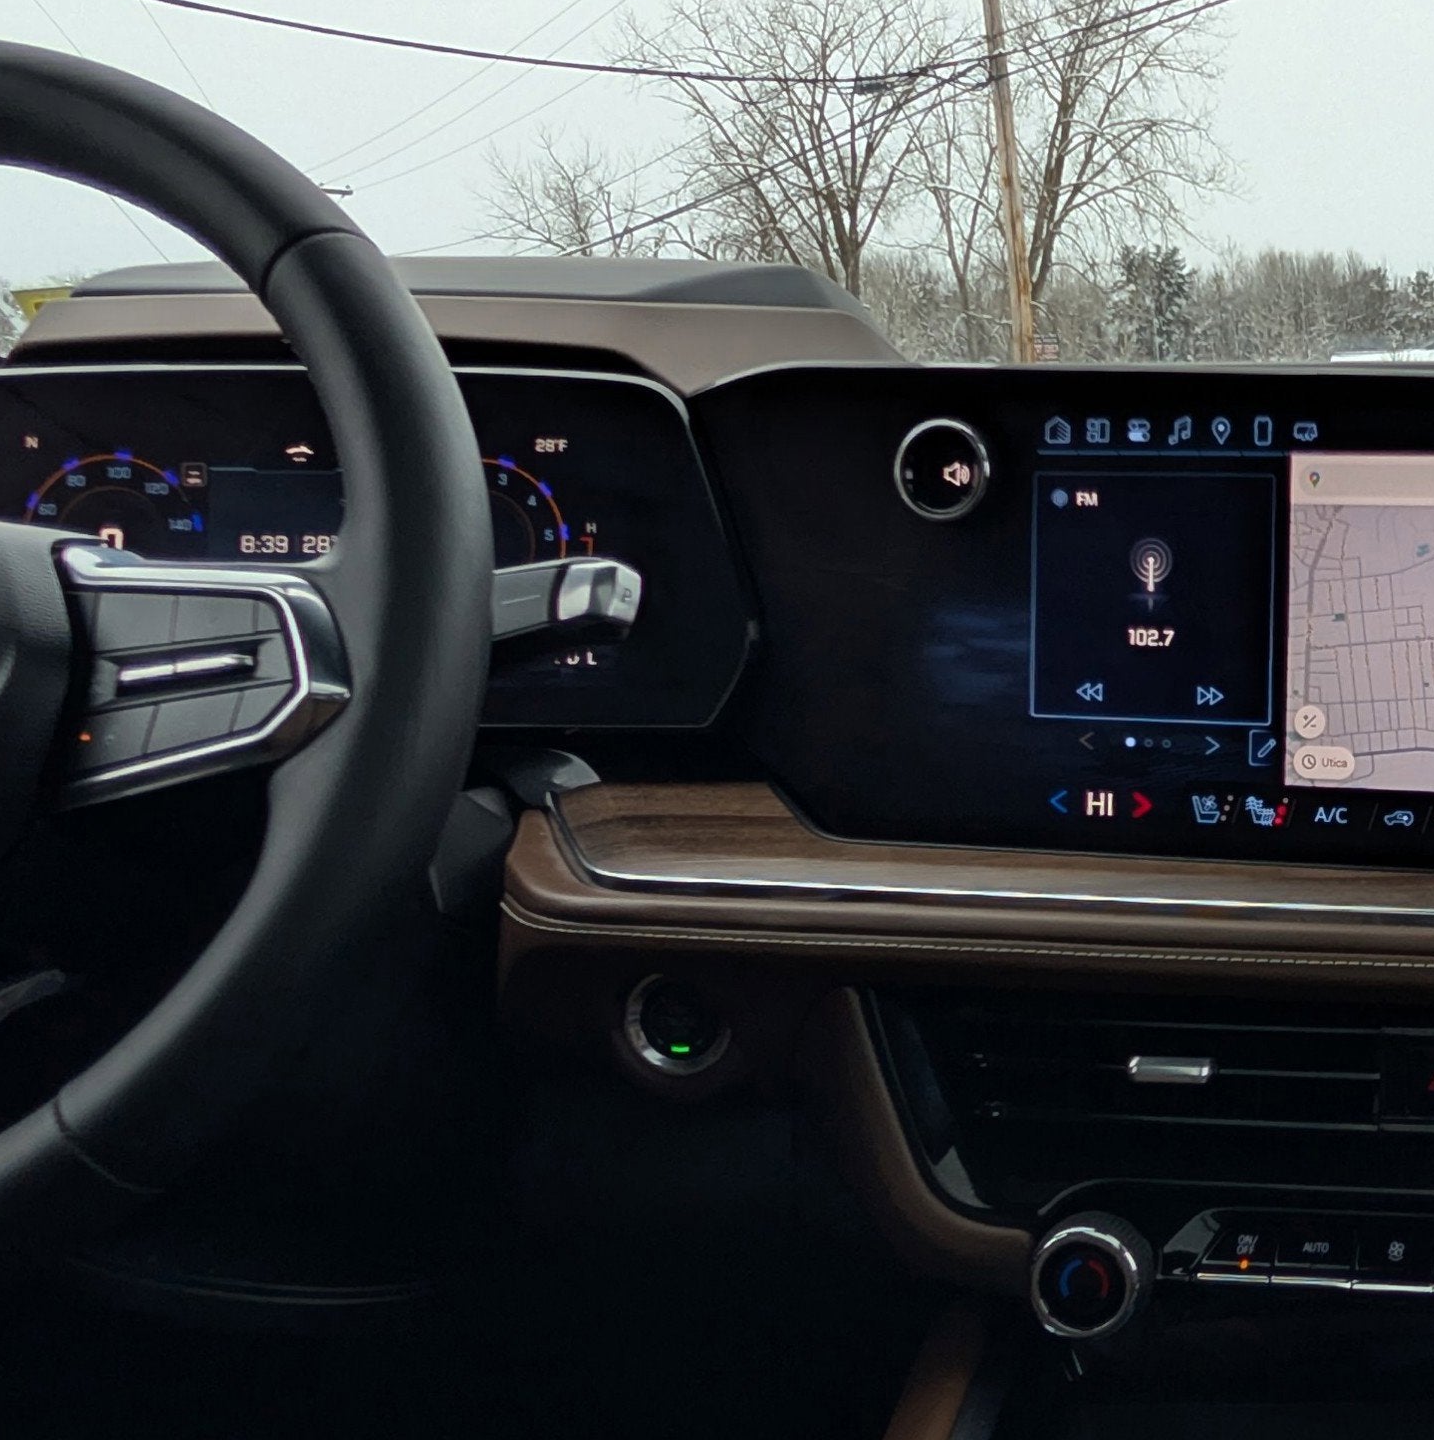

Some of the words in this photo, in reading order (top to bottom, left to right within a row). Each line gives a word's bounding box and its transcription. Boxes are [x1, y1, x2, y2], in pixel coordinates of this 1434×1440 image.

[25, 435, 39, 449] N
[1075, 491, 1099, 508] FM
[239, 534, 289, 554] 8:39
[1127, 629, 1176, 647] 102.7
[1322, 757, 1349, 768] Utica
[1086, 793, 1114, 816] HI
[1313, 806, 1348, 825] A/C
[1302, 1241, 1330, 1253] AUTO
